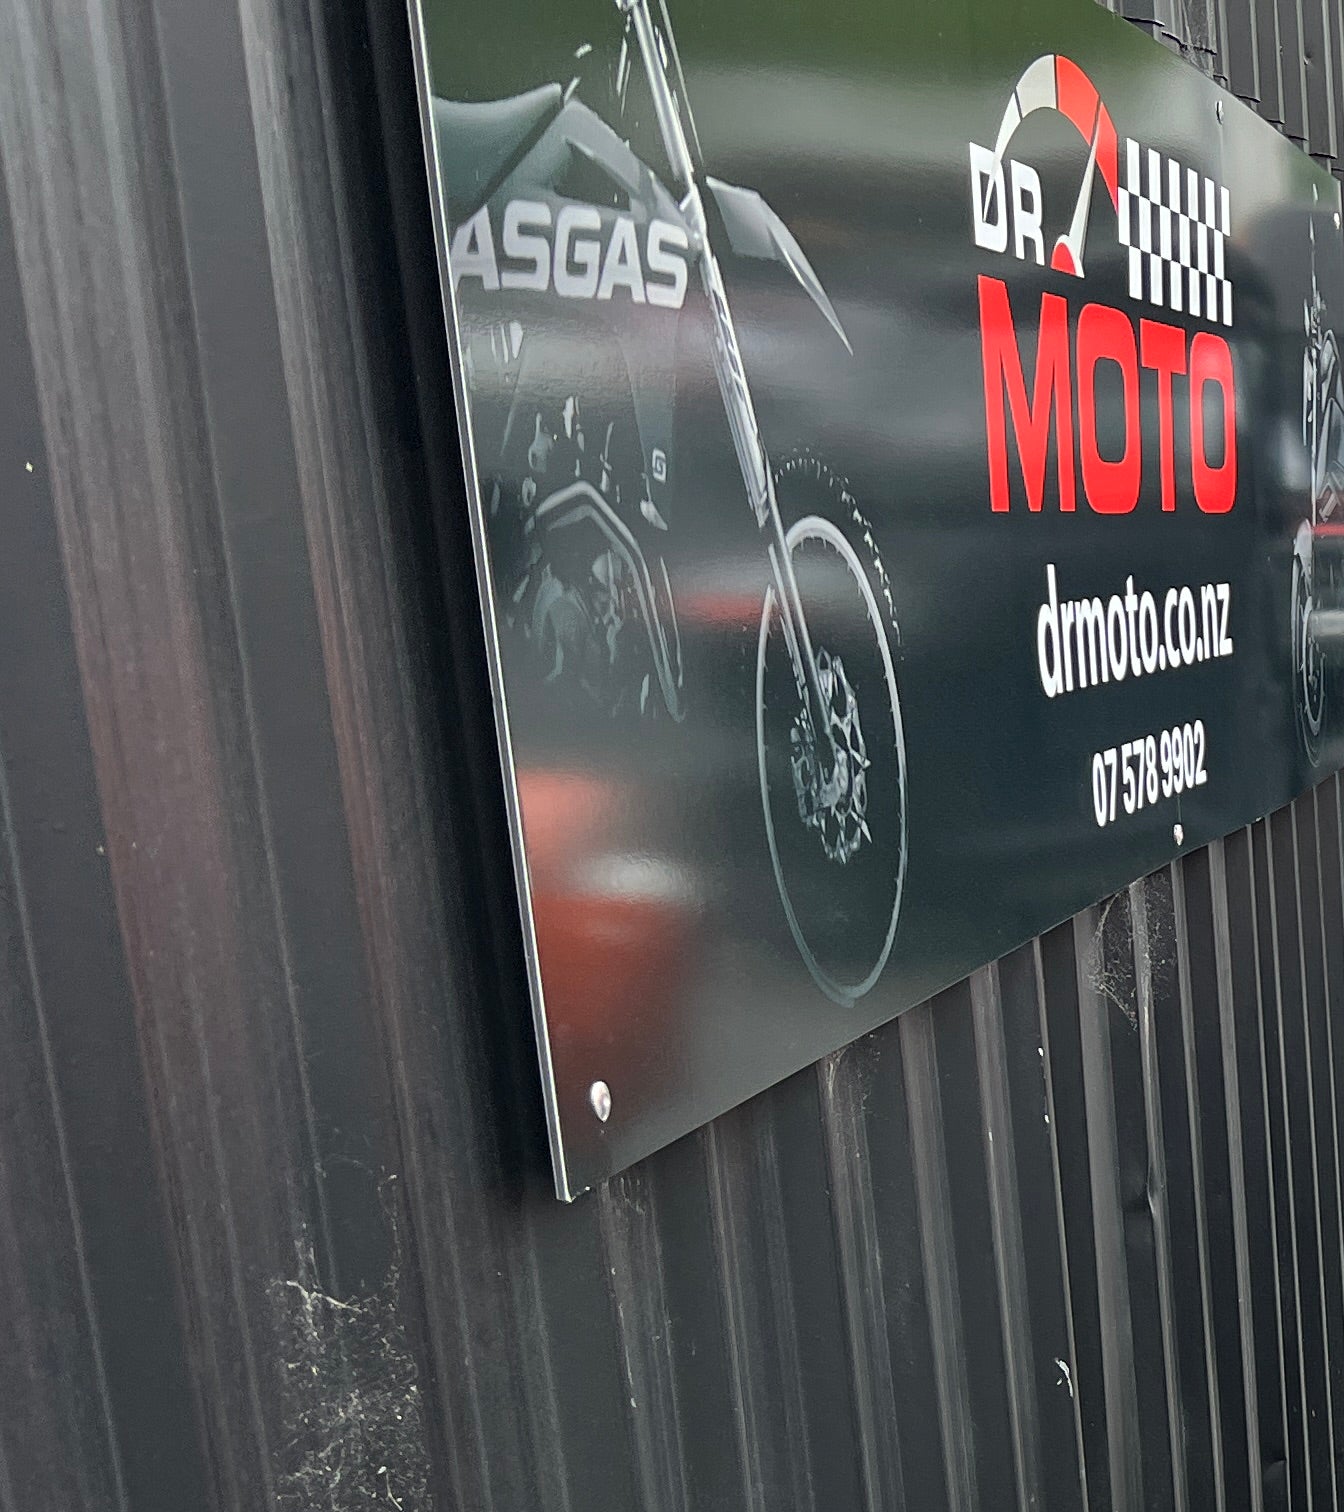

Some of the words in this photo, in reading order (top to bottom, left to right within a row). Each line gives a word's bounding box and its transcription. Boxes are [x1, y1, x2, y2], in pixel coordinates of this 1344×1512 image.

[977, 274, 1237, 514] MOTO
[1037, 563, 1233, 698] drmoto.co.nz
[1092, 747, 1117, 827] 07
[1121, 734, 1159, 814] 578
[1160, 719, 1208, 798] 9902
